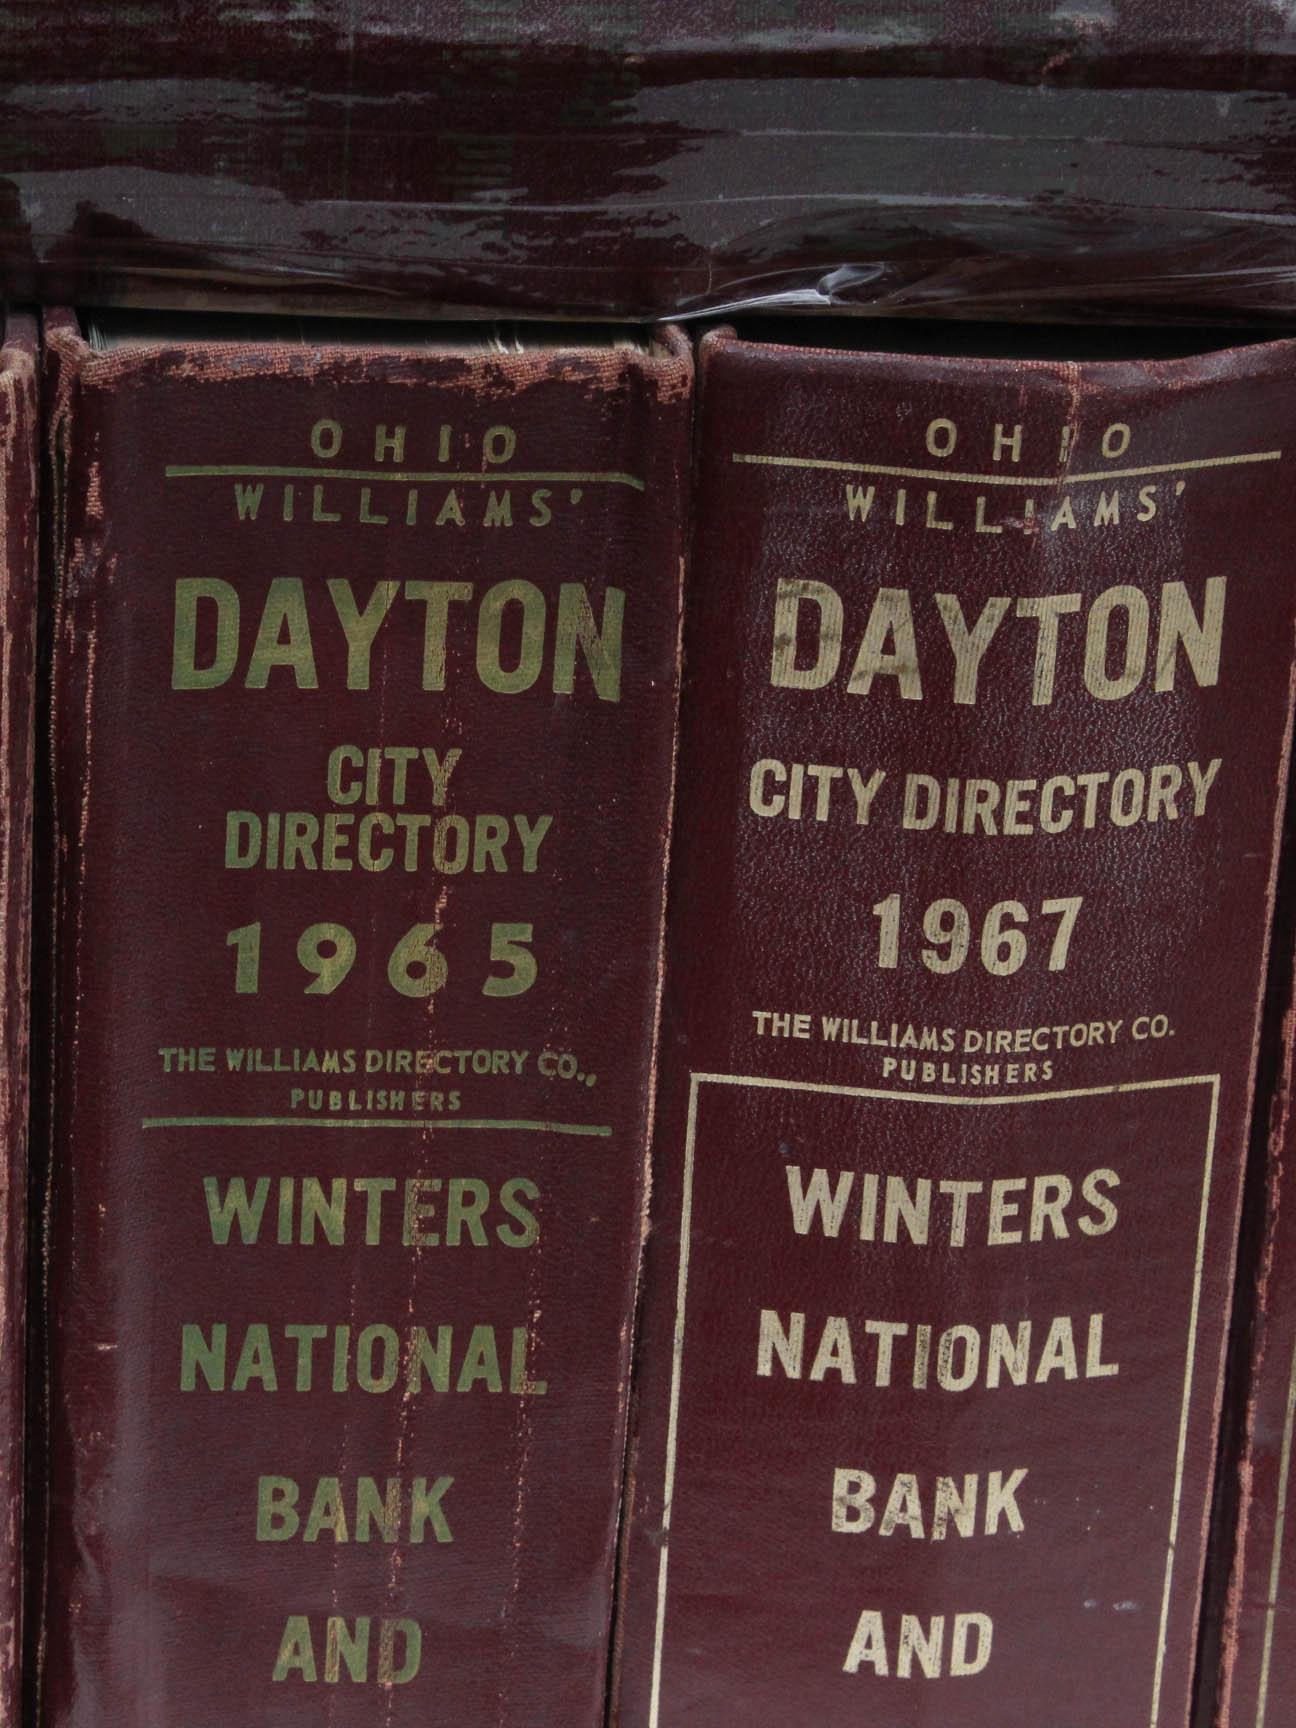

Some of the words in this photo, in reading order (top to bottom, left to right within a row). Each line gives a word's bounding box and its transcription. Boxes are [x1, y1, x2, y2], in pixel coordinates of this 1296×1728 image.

[311, 419, 516, 463] OHIO
[925, 418, 1131, 462] OHIO
[234, 483, 583, 527] WILLIAMS'
[846, 481, 1186, 535] WILLIAMS'
[171, 576, 625, 702] DAYTON
[770, 576, 1227, 706] DAYTON
[327, 744, 462, 806] CITY
[748, 758, 886, 826] CITY
[903, 758, 1223, 837] DIRECTORY
[225, 810, 554, 875] DIRECTORY
[225, 921, 538, 998] 1965
[872, 893, 1084, 977] 1967
[158, 1047, 217, 1073] THE
[226, 1047, 357, 1074] WILLIAMS
[365, 1048, 530, 1076] DIRECTORY
[752, 1010, 812, 1040] THE
[822, 1016, 956, 1054] WILLIAMS
[963, 1019, 1124, 1055] DIRECTORY
[1131, 1014, 1176, 1041] CO.
[291, 1088, 462, 1112] PUBLISHERS
[883, 1057, 1054, 1085] PUBLISHERS
[203, 1176, 542, 1249] WINTERS
[785, 1165, 1122, 1249] WINTERS
[179, 1323, 548, 1395] NATIONAL
[756, 1309, 1120, 1393] NATIONAL
[255, 1475, 456, 1544] BANK
[831, 1467, 1029, 1541] BANK
[271, 1615, 423, 1684] AND
[842, 1609, 994, 1679] AND
